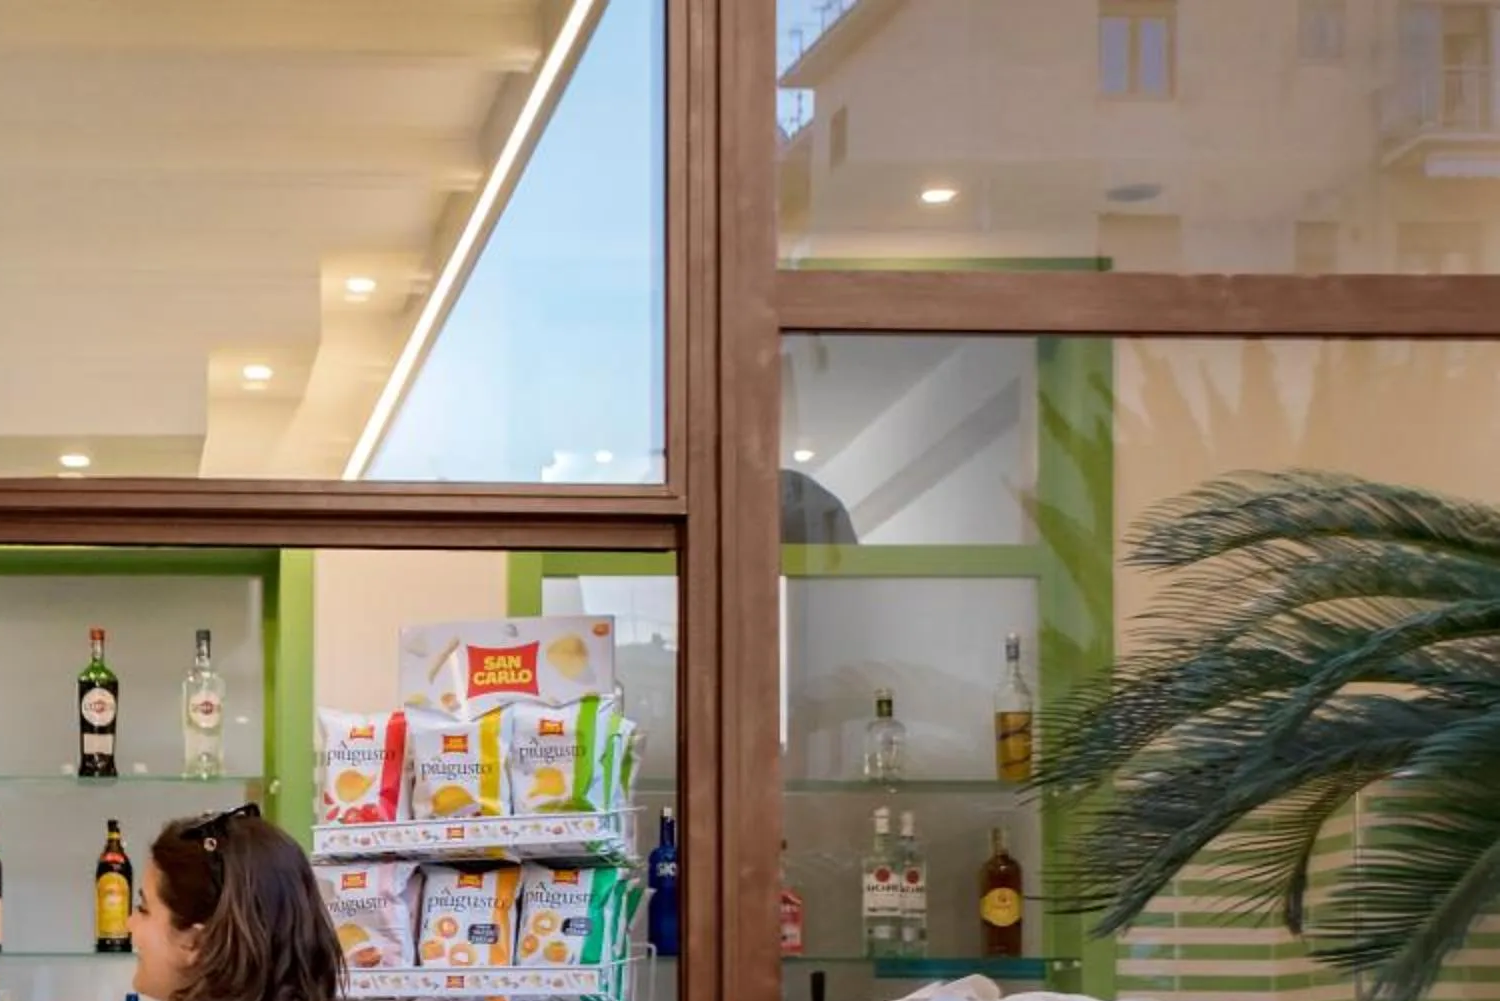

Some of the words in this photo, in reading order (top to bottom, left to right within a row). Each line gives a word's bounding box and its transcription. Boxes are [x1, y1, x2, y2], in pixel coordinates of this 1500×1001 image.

[483, 655, 522, 671] SAN
[473, 668, 533, 687] CARLO
[525, 882, 594, 909] piùgust
